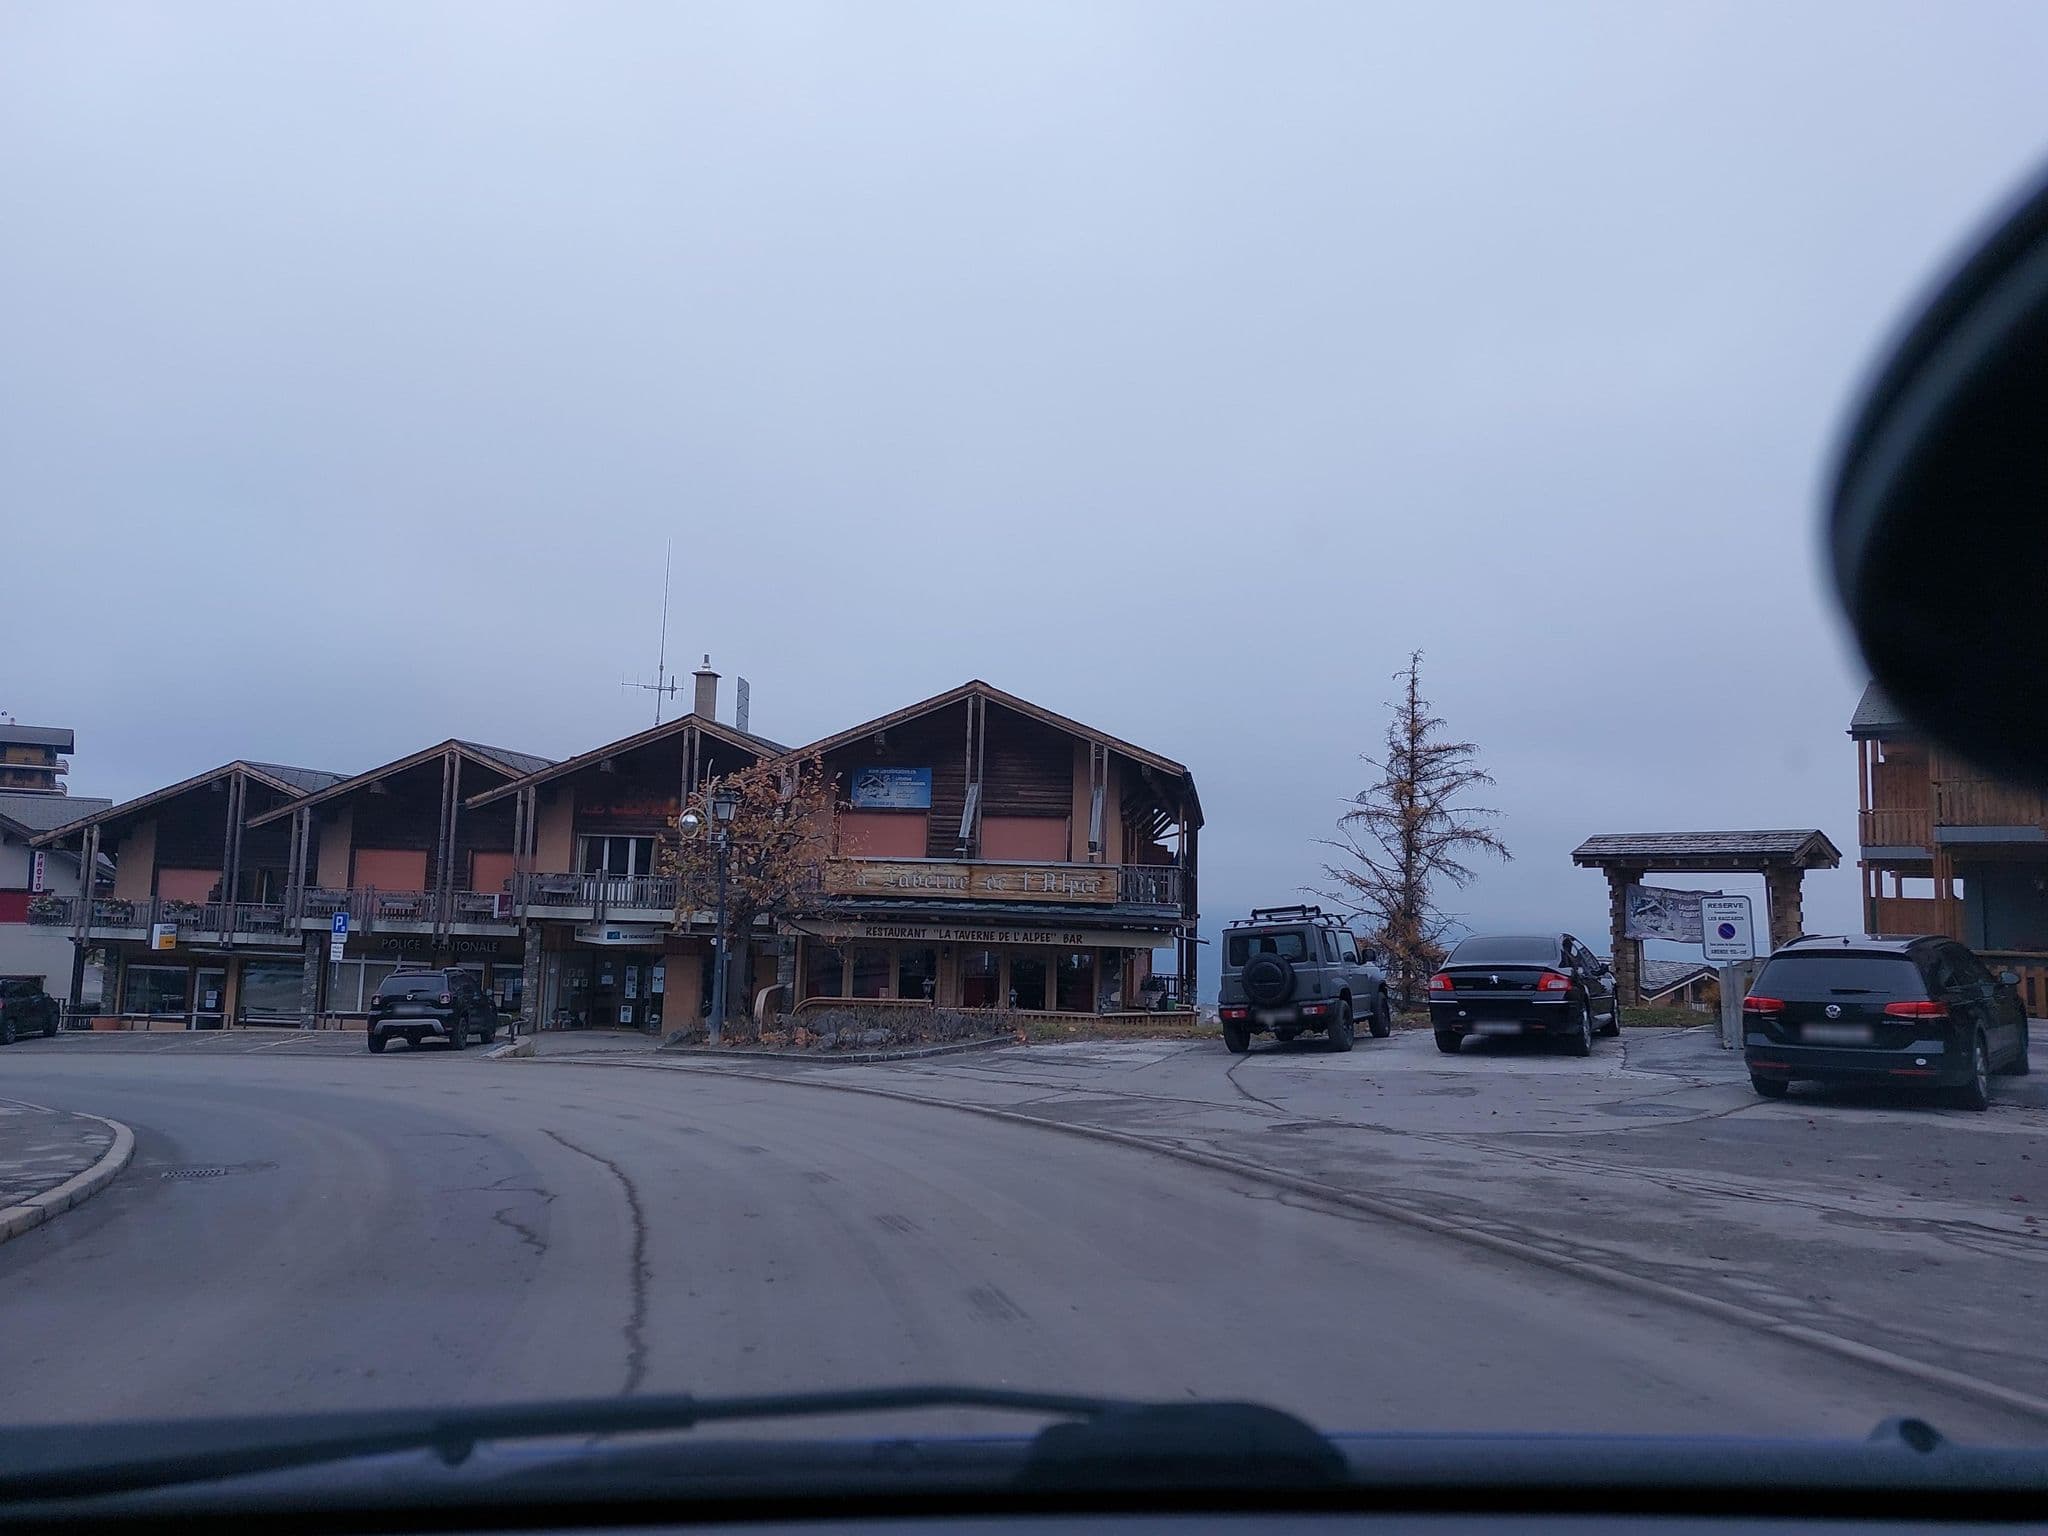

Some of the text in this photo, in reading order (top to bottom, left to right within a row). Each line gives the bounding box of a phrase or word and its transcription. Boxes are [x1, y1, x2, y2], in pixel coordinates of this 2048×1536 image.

[36, 853, 44, 889] PHOTO
[335, 915, 344, 931] P
[865, 926, 928, 938] RESTAURANT
[953, 930, 996, 941] TAVERNE
[998, 931, 1010, 941] DE
[1063, 933, 1083, 944] BAR
[382, 938, 420, 950] POLICE
